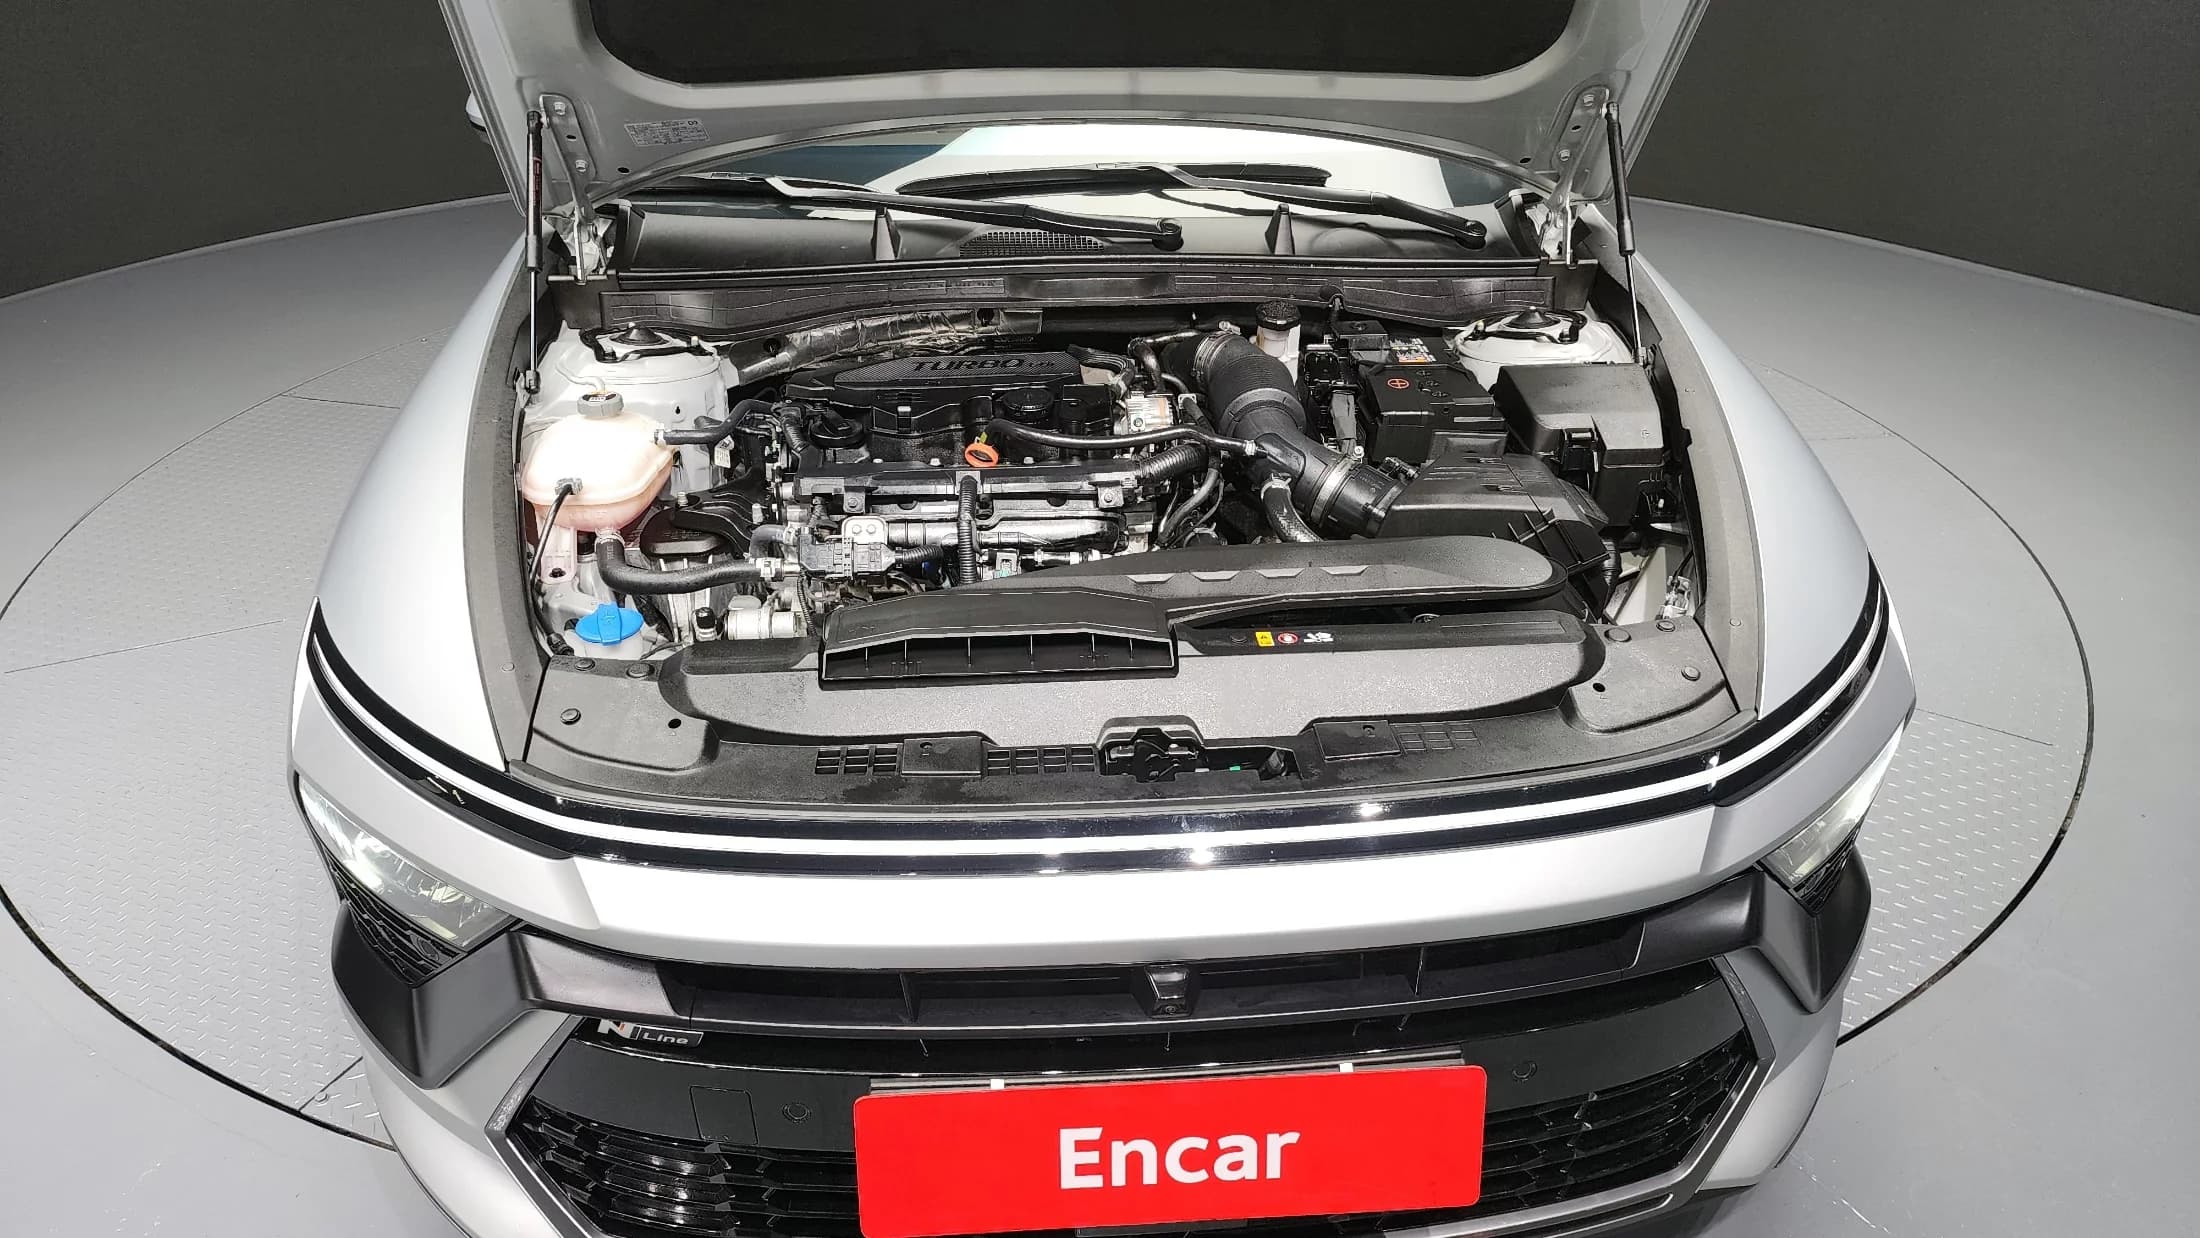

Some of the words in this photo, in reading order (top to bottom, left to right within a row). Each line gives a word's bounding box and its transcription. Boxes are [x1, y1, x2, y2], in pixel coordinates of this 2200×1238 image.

[912, 358, 1025, 372] TURBO
[642, 1032, 689, 1045] Line
[1059, 1126, 1301, 1190] Encar
